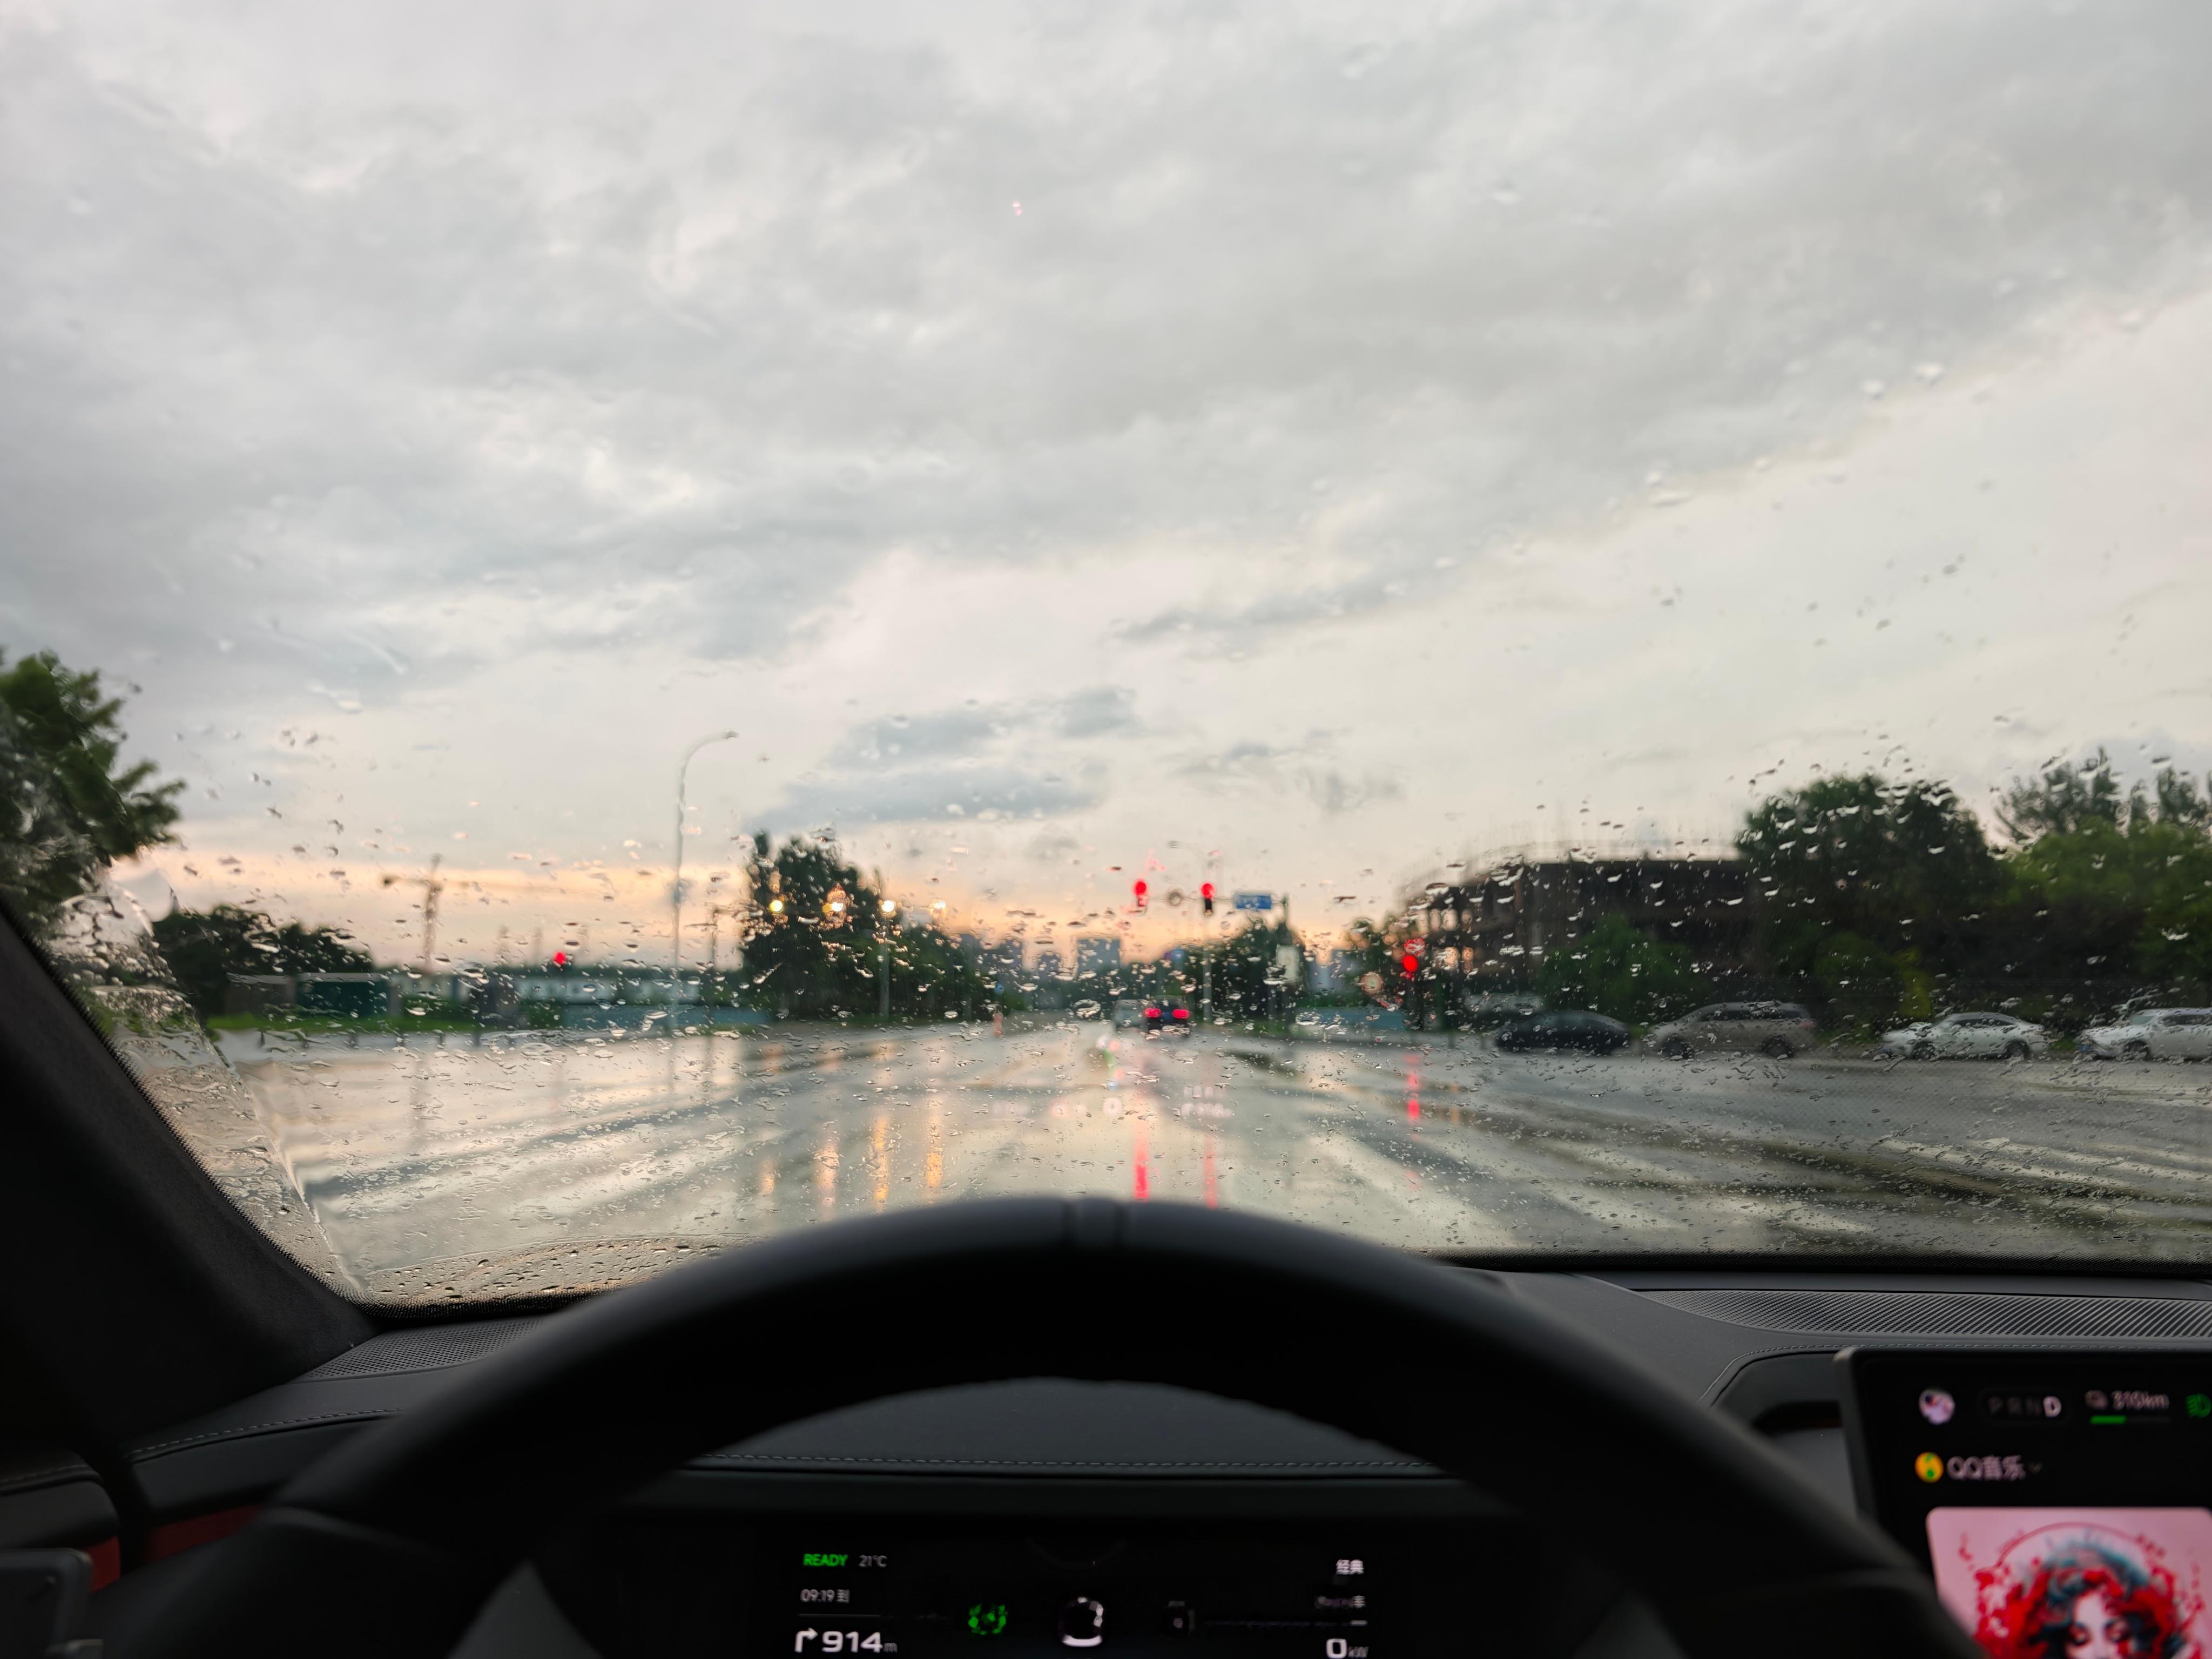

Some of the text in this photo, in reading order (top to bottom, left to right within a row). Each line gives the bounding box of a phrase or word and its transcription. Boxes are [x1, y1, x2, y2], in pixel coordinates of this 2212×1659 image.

[2043, 1395, 2062, 1418] D
[1947, 1454, 2027, 1480] QQ音乐
[803, 1554, 888, 1567] READY 21°C
